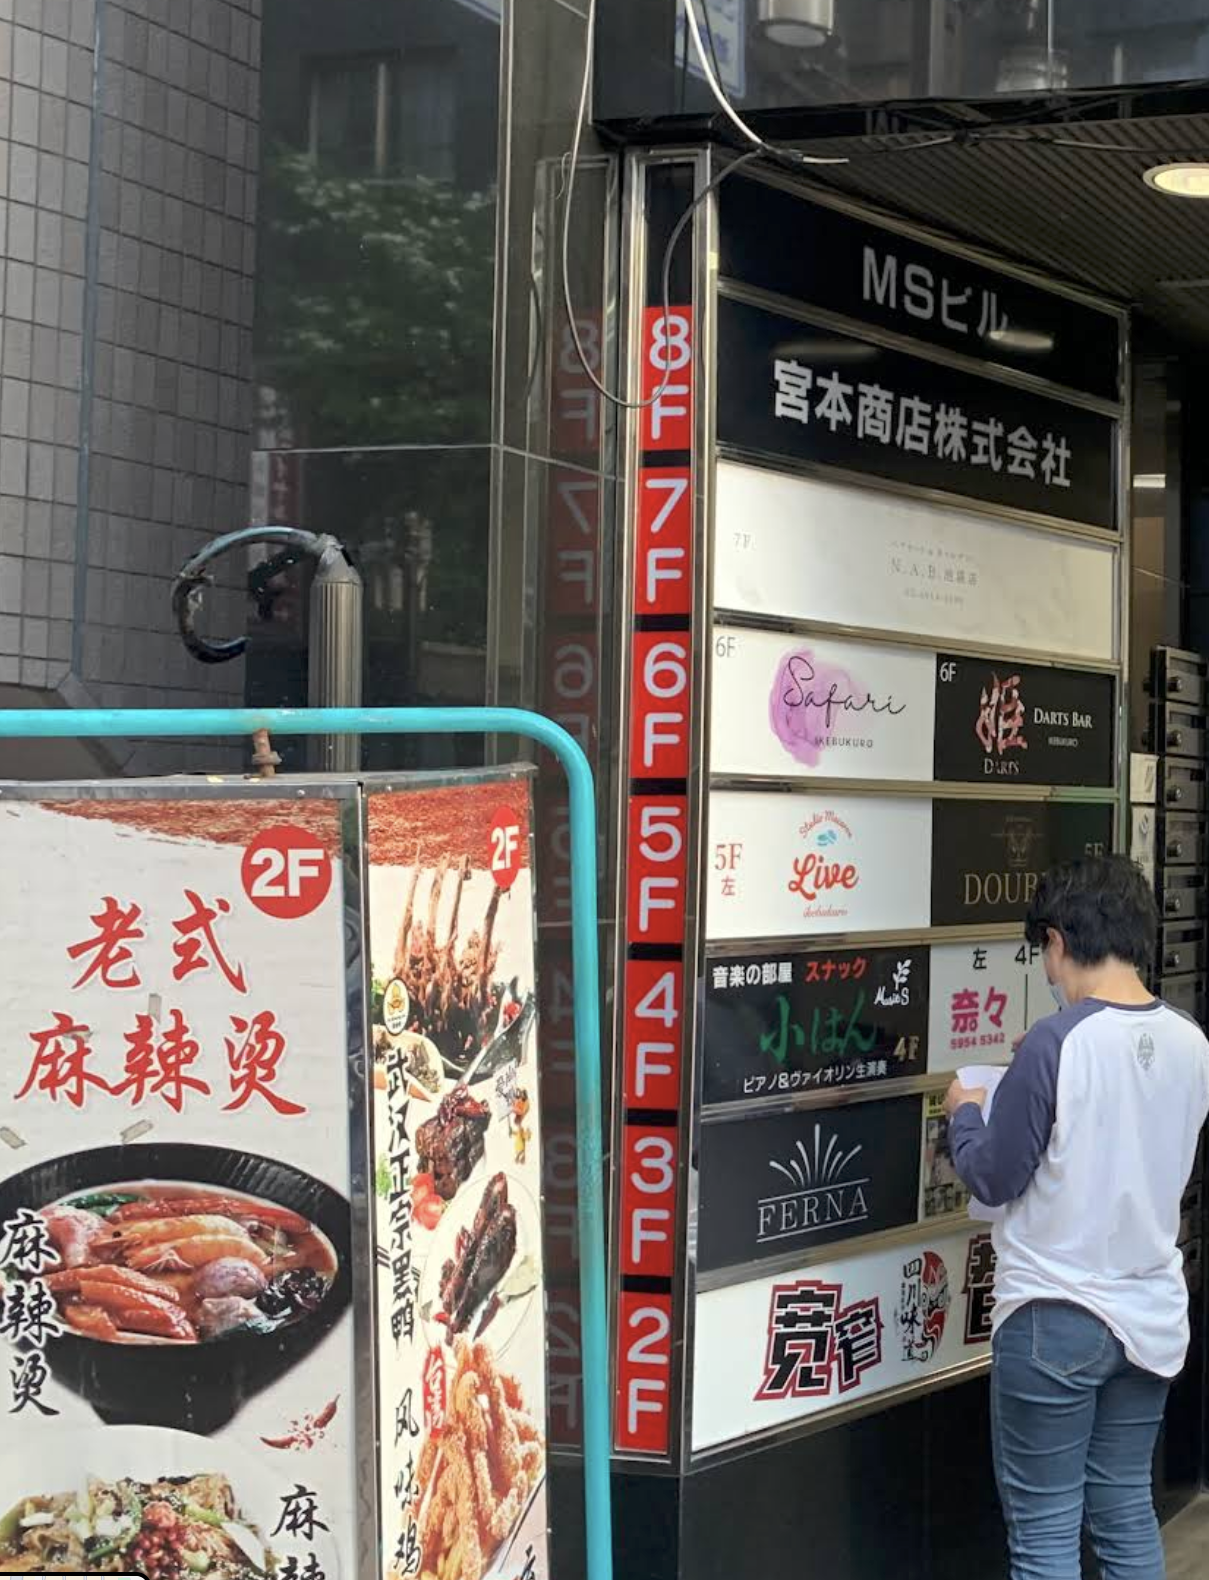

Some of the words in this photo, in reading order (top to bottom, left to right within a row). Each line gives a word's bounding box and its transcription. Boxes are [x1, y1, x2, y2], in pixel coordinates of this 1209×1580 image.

[863, 246, 1008, 338] MSビル
[649, 315, 691, 440] 8F
[773, 358, 1073, 488] 宮本商店株式会社
[646, 478, 688, 603] 7F
[715, 636, 737, 658] 6F
[939, 662, 957, 682] 6F
[644, 642, 687, 767] 6F
[783, 655, 907, 728] Safari
[250, 847, 325, 898] 2F
[490, 825, 520, 871] 2F
[639, 806, 682, 932] 5F
[714, 843, 743, 870] 5F
[720, 875, 737, 896] 左
[788, 852, 860, 901] Live
[963, 872, 1047, 905] DOUB
[66, 888, 249, 994] 老式
[972, 948, 988, 970] 左
[1014, 945, 1040, 965] 4F
[712, 961, 793, 989] 音楽の部屋
[804, 956, 868, 982] スナック
[634, 971, 678, 1097] 4F
[950, 986, 1009, 1034] 奈々
[13, 1008, 308, 1117] 麻辣烫
[894, 1036, 920, 1061] 4F
[950, 1036, 979, 1051] 5954
[630, 1136, 674, 1264] 3F
[757, 1186, 870, 1237] FERNA
[0, 1210, 61, 1416] 麻辣烫
[627, 1306, 671, 1434] 2F
